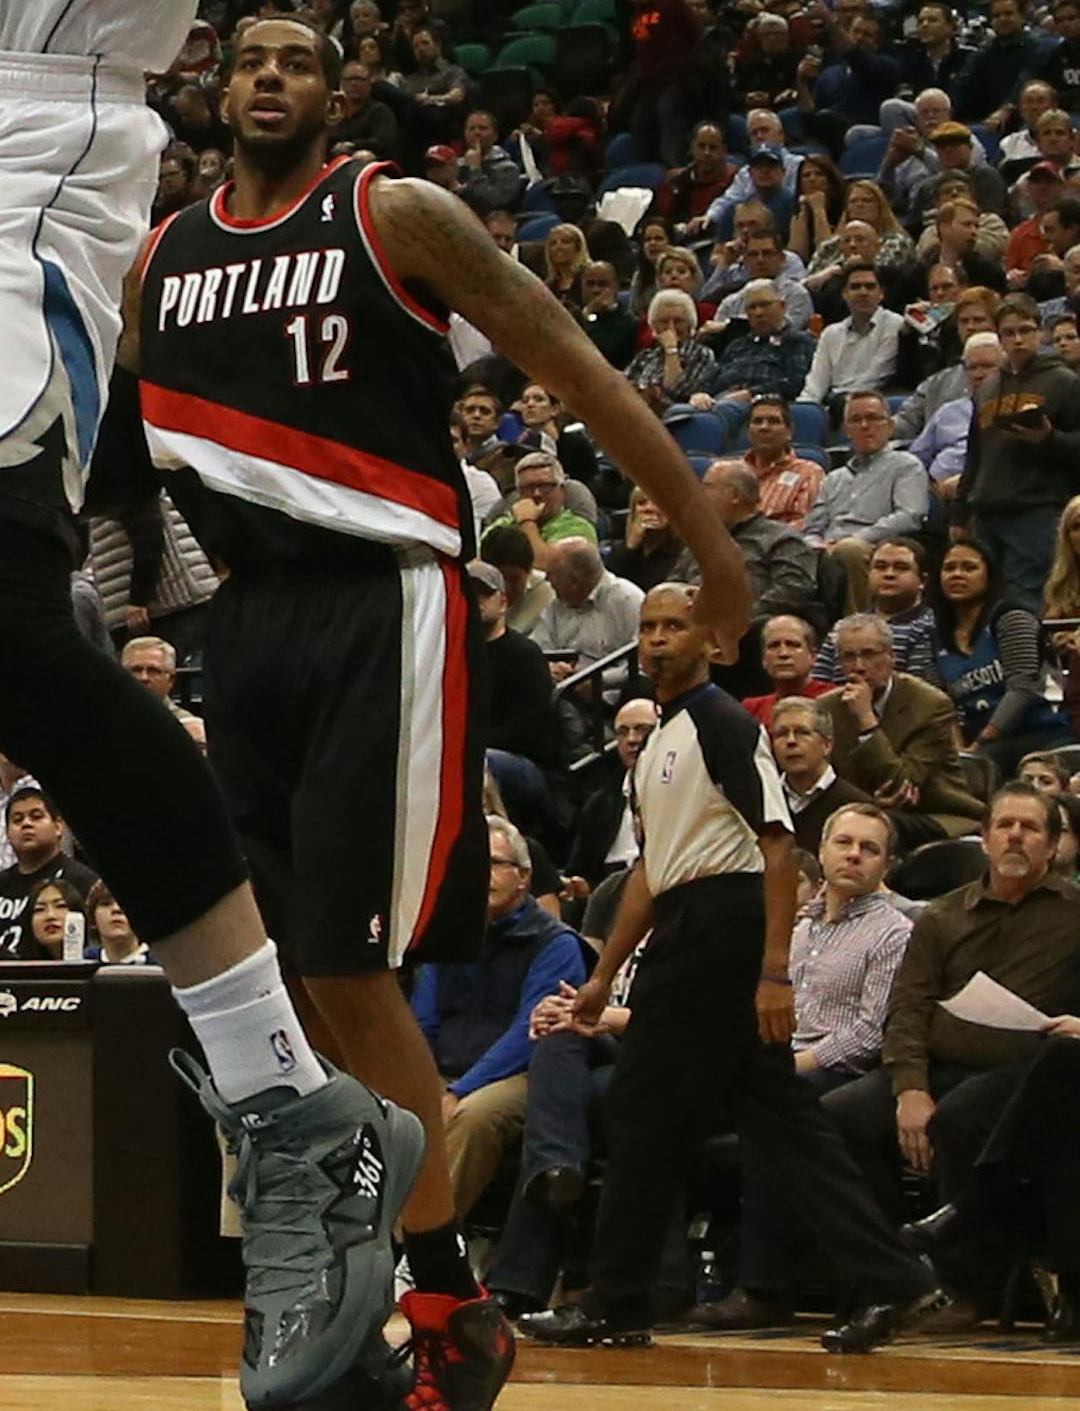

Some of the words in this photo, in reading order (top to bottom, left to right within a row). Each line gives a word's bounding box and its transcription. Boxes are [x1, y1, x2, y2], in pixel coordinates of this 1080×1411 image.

[158, 248, 346, 331] PORTLAND
[286, 314, 349, 383] 12
[21, 997, 81, 1011] ANC
